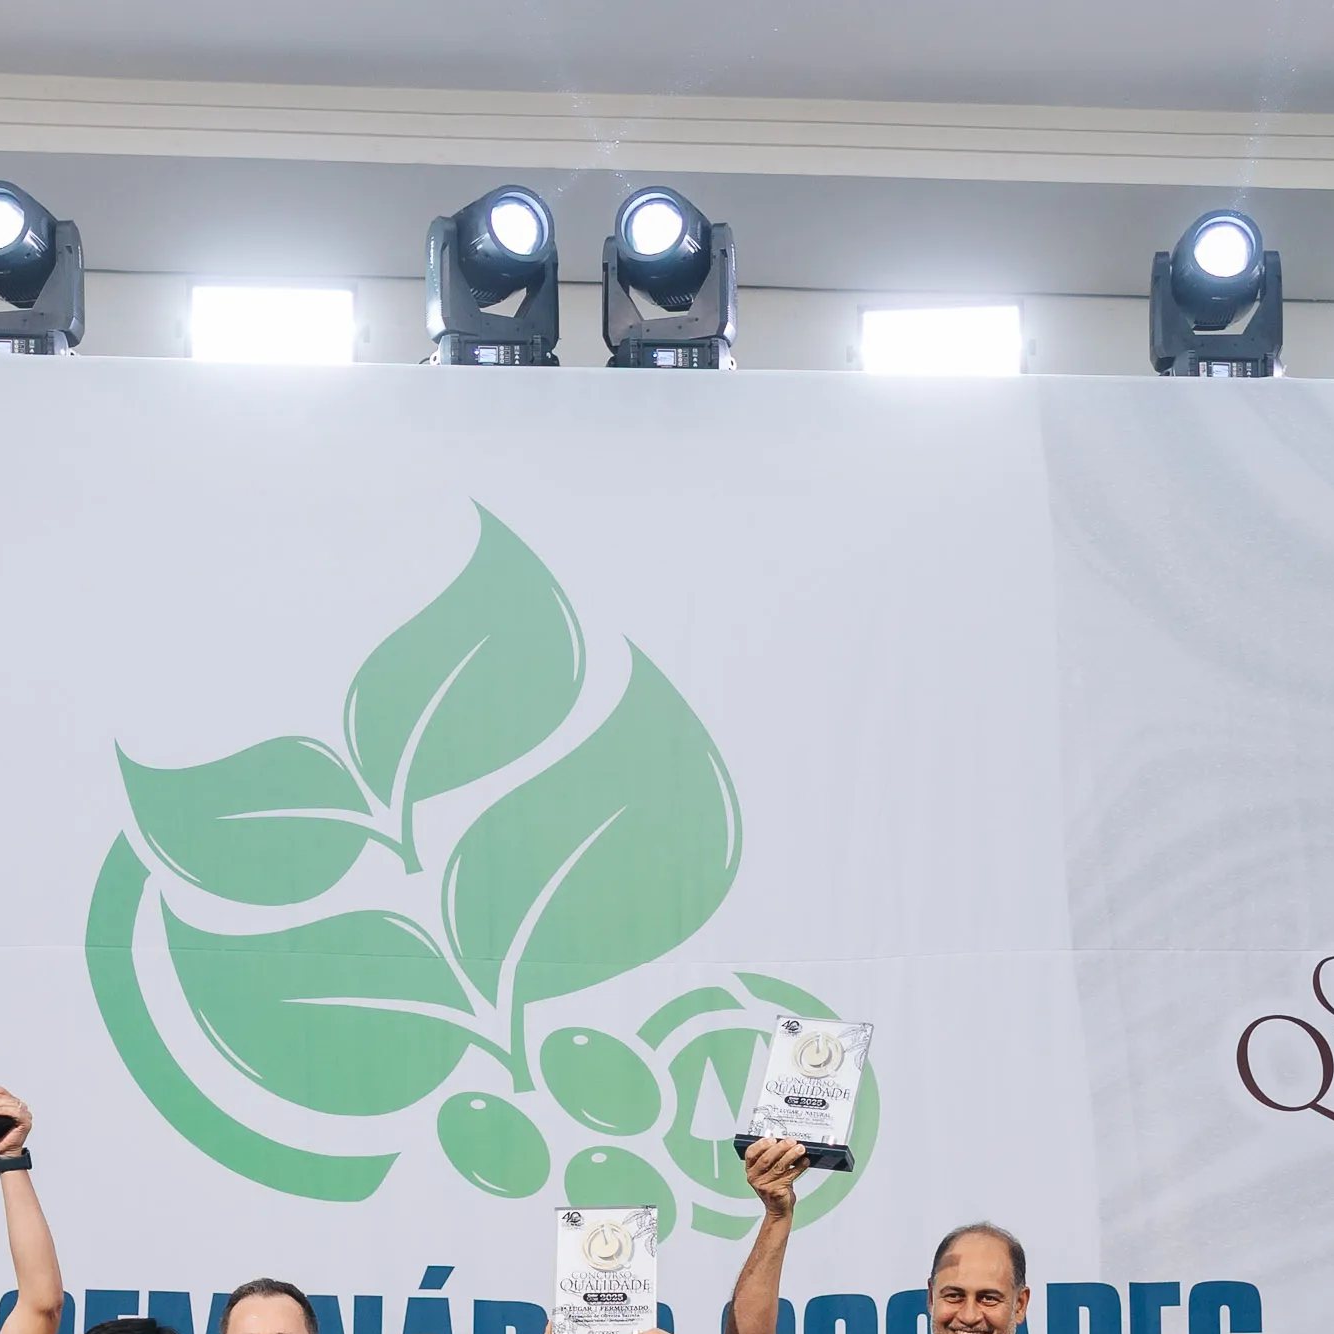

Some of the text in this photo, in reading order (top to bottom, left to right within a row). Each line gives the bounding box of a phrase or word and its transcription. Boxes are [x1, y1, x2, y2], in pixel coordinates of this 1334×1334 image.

[765, 1080, 851, 1100] QUALIDADE
[571, 1271, 632, 1280] CONCURSO
[560, 1279, 651, 1294] QUALIDADE
[599, 1293, 624, 1301] 2025
